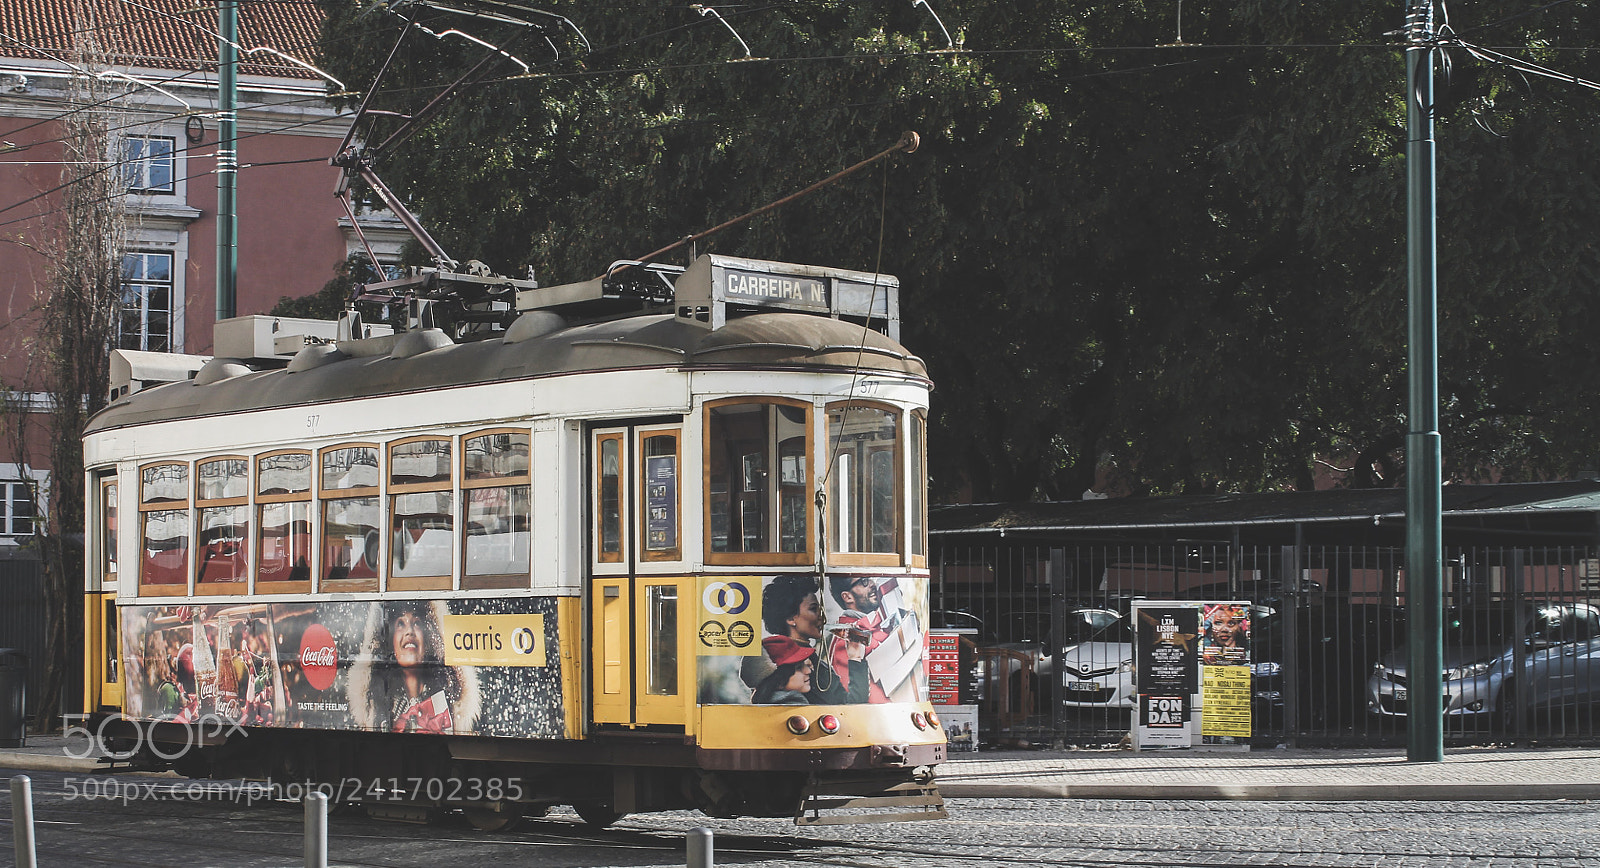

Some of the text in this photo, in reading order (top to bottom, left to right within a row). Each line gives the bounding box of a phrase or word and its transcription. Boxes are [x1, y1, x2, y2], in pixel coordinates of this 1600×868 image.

[728, 274, 803, 300] CARREIRA
[860, 380, 880, 394] 577
[306, 414, 320, 428] 577
[1156, 625, 1180, 633] LISBON
[453, 625, 502, 651] carris
[302, 646, 336, 667] Coca-Cola
[297, 702, 349, 712] TASTE THE FEELING
